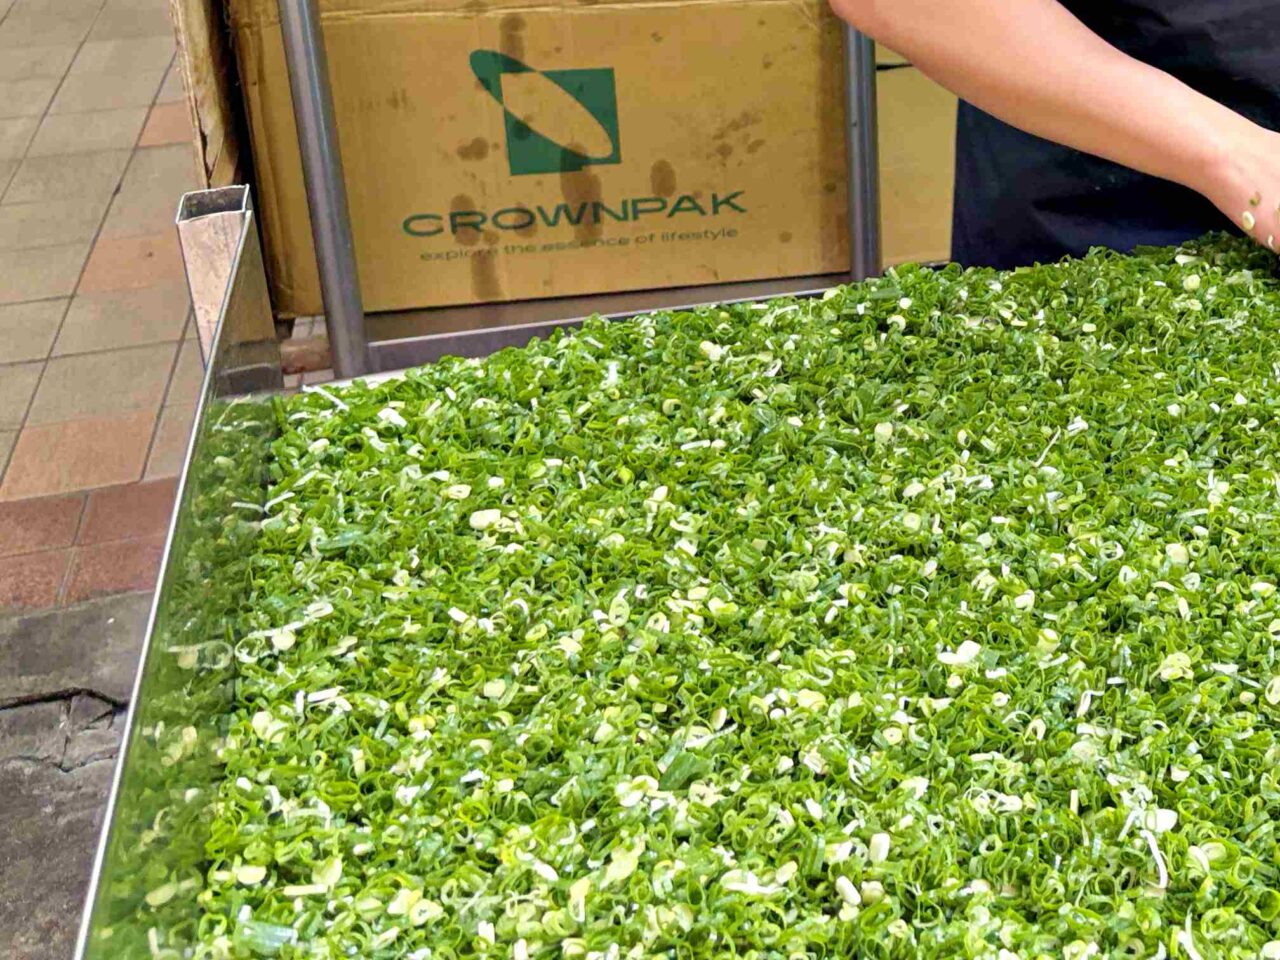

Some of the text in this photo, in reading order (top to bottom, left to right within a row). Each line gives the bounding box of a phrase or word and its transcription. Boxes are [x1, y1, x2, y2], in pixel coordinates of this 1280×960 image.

[402, 191, 748, 237] CROWNPAK
[420, 248, 499, 262] explore
[504, 244, 537, 255] the
[635, 233, 656, 245] of
[661, 227, 738, 242] lifestyle
